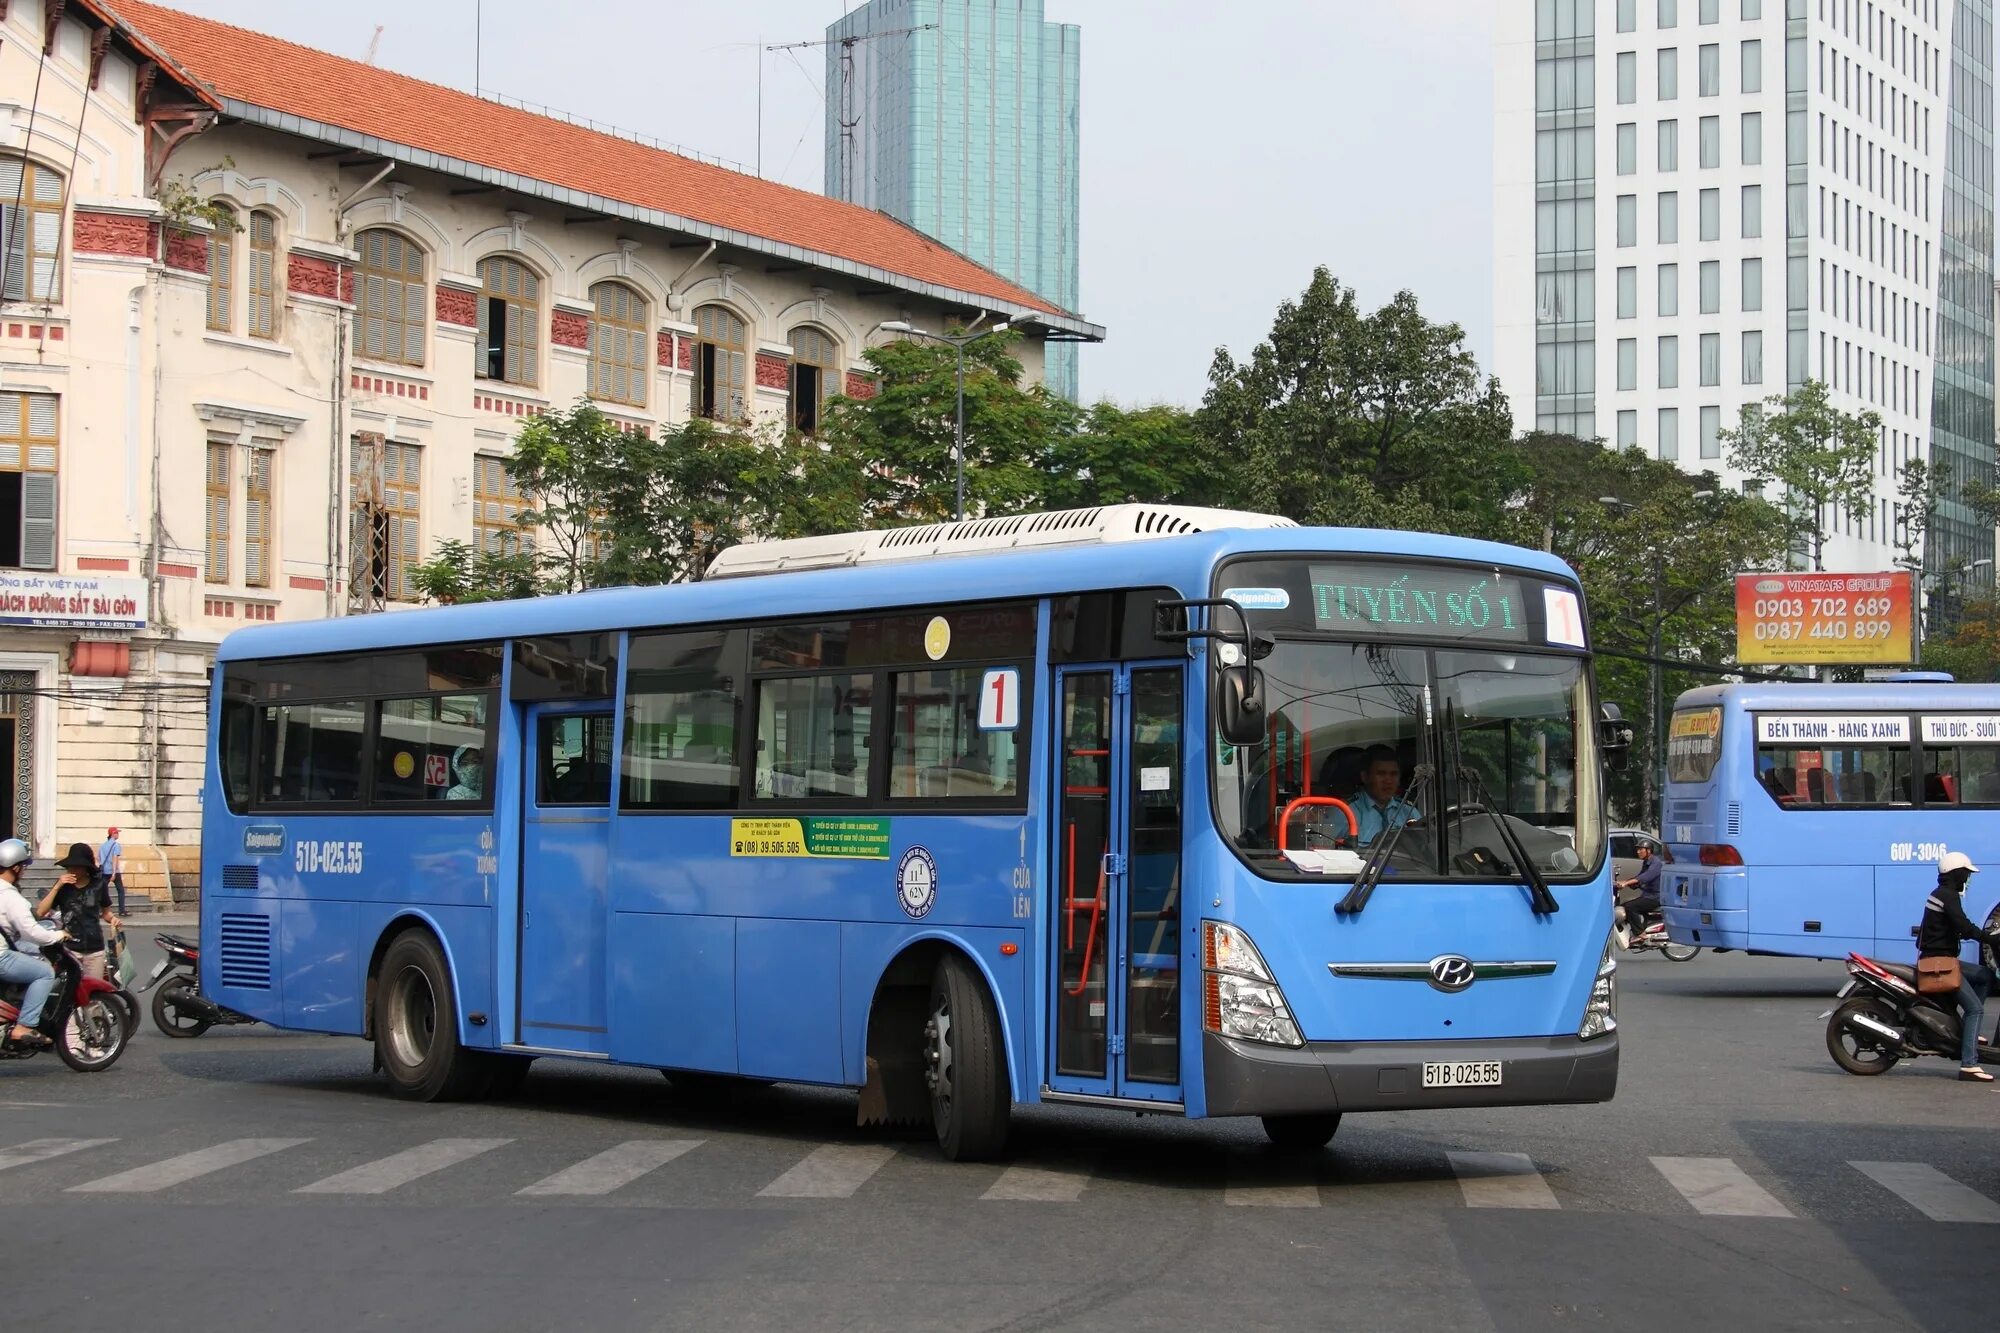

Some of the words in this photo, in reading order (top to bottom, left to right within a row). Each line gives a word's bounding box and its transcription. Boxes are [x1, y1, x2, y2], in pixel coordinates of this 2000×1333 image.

[24, 577, 44, 588] SẮT
[48, 579, 71, 590] VIỆT
[74, 581, 98, 590] NAM
[1787, 580, 1845, 592] VINATAFS
[1847, 579, 1892, 592] GROUP
[69, 590, 90, 614] SẮT
[93, 594, 111, 615] SÀI
[114, 594, 136, 615] GÒN
[1312, 575, 1437, 624] TUYẾN
[1446, 580, 1490, 627] SỐ
[1499, 596, 1515, 629] 1
[1754, 599, 1804, 618] 0903
[1811, 598, 1847, 617] 702
[1853, 598, 1892, 617] 689
[1554, 595, 1571, 641] 1
[1754, 621, 1803, 640] 0987
[1809, 620, 1848, 639] 440
[1854, 620, 1892, 640] 899
[991, 673, 1005, 724] 1
[1768, 717, 1789, 738] BẾN
[1792, 719, 1828, 738] THÀNH
[1838, 719, 1868, 738] HÀNG
[1871, 722, 1901, 738] XANH
[1950, 719, 1968, 737] ĐỨC
[1976, 717, 1997, 737] SUỐI
[296, 841, 363, 874] 51B-025.55
[745, 840, 758, 854] (08)
[760, 841, 800, 853] 39.505.505
[1890, 842, 1947, 862] 60V-3046
[1013, 859, 1031, 889] CỬA
[909, 887, 924, 899] 62N
[1013, 891, 1031, 918] LÊN
[1426, 1063, 1499, 1085] 51B-025.55
